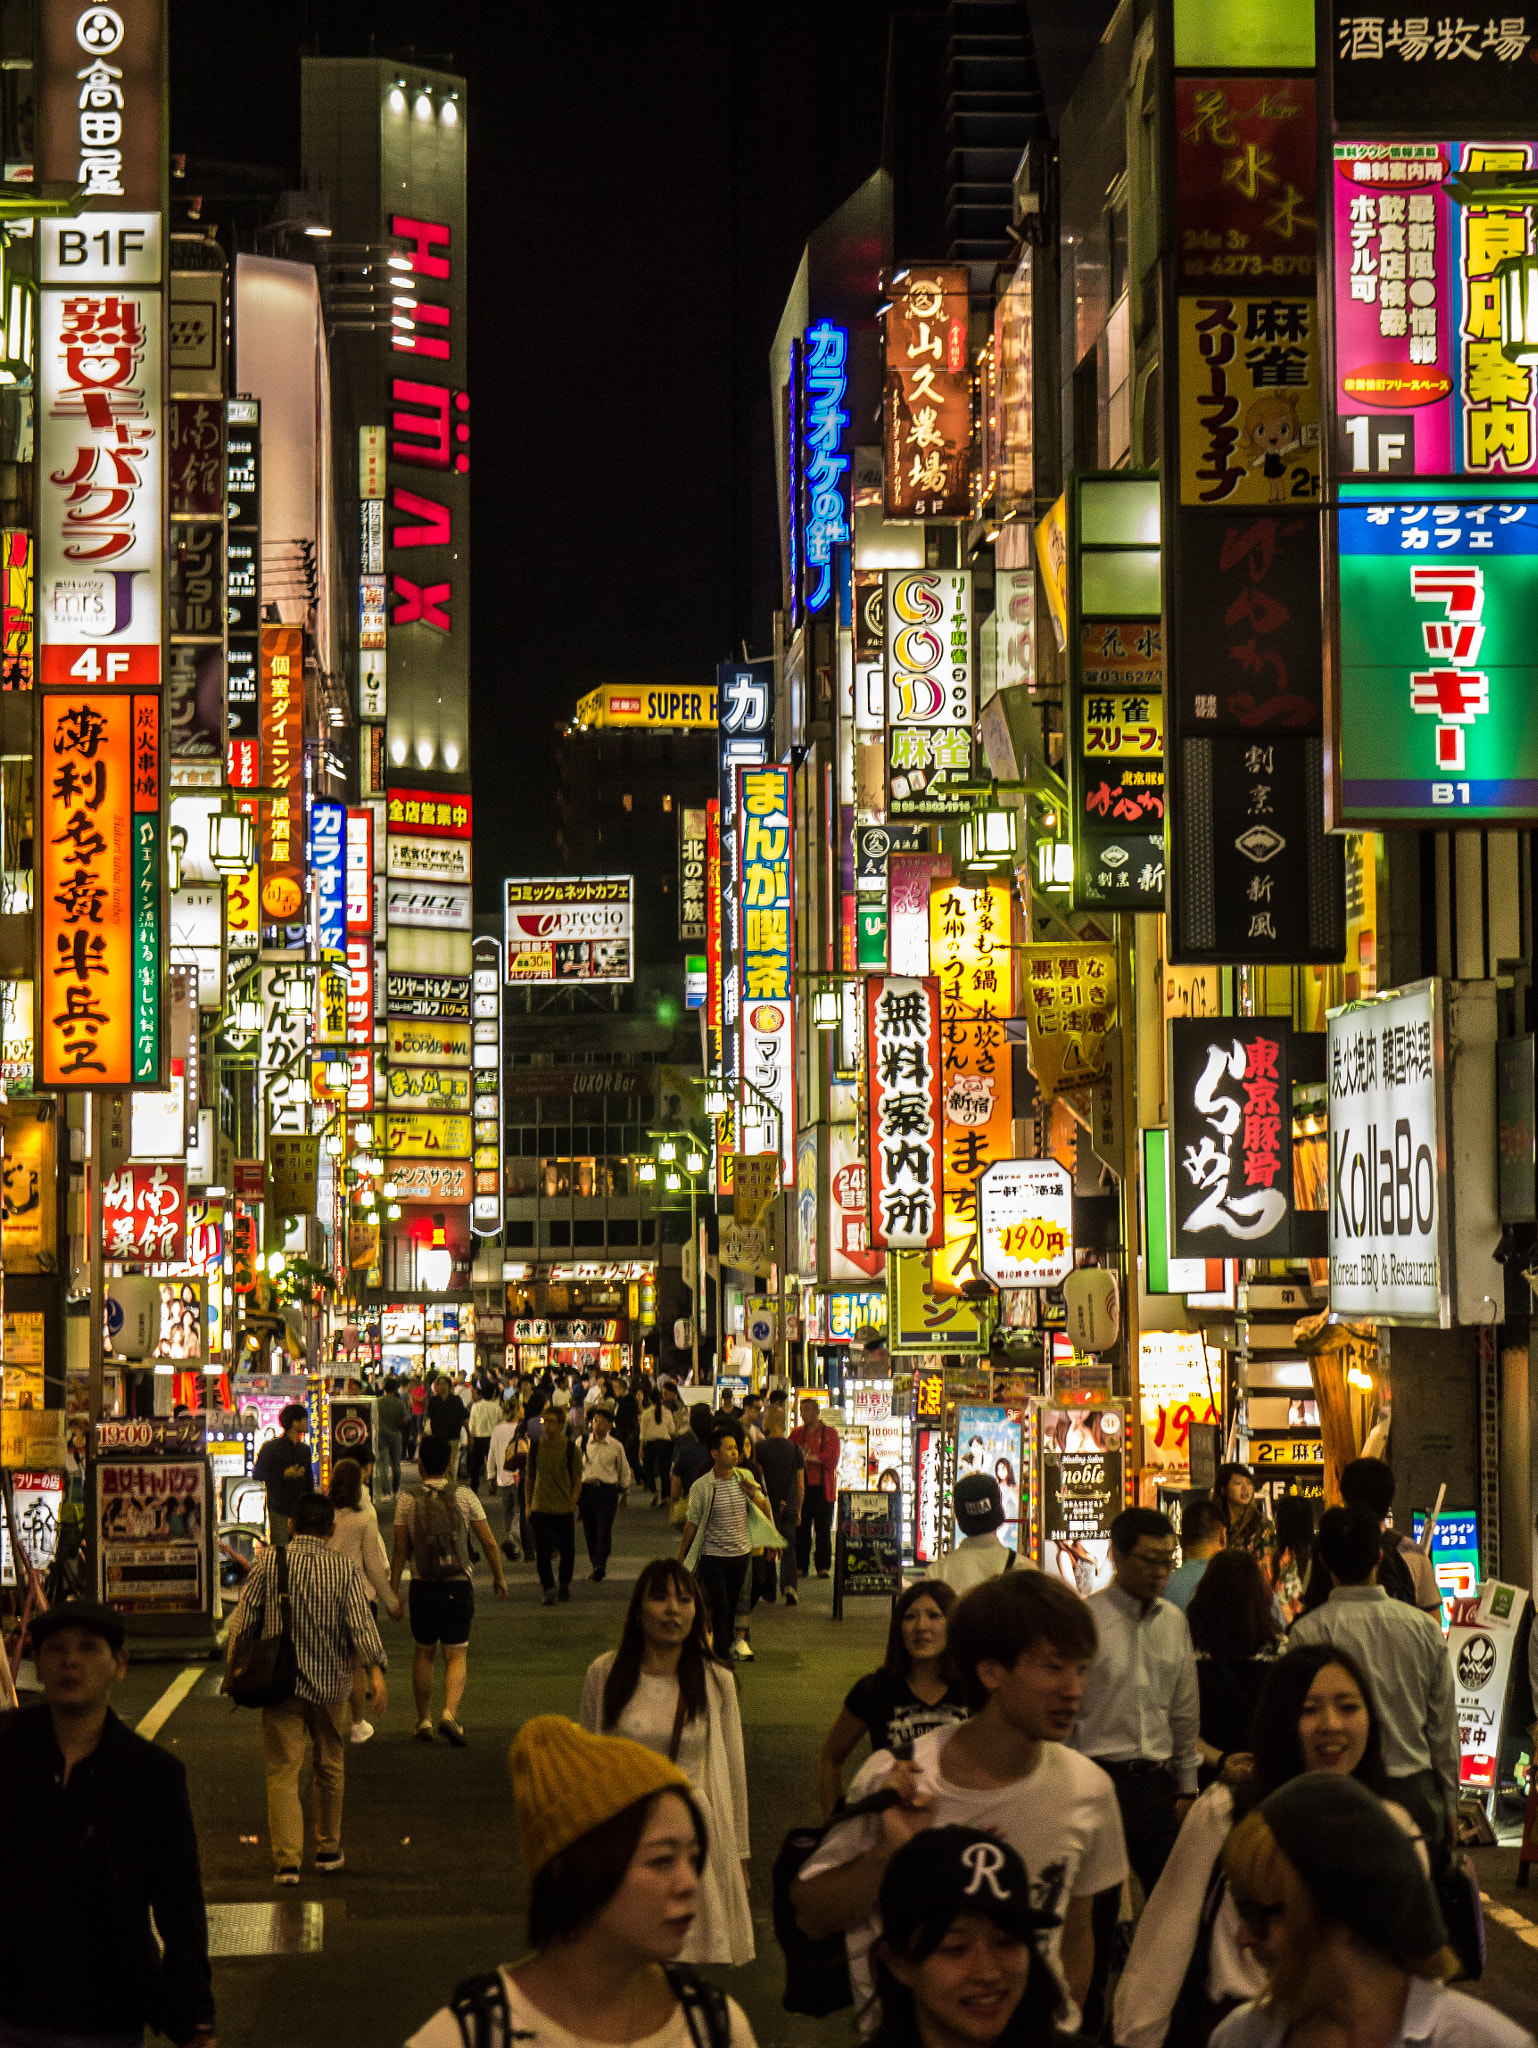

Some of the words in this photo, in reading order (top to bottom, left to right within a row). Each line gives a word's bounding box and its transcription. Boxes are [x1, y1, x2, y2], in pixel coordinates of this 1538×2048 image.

[1340, 17, 1531, 62] 酒場牧場
[1353, 162, 1443, 181] 無料案内所
[58, 230, 146, 267] B1F
[1350, 194, 1378, 304] ホテル可
[1245, 302, 1309, 389] 麻雀
[906, 321, 949, 493] 山久農場
[1194, 301, 1249, 502] スリーファイブ
[1346, 416, 1406, 473] 1F
[1367, 504, 1528, 525] オンライン
[1400, 528, 1495, 549] カフェ
[951, 577, 967, 665] リーチ麻雀
[69, 647, 131, 682] 4F
[892, 572, 947, 723] GOD
[1409, 565, 1490, 771] ラッキー
[648, 691, 702, 721] SUPER
[1087, 697, 1151, 723] 麻雀
[890, 726, 972, 770] 麻雀
[1431, 784, 1471, 805] B1
[388, 798, 469, 829] 全店営業中
[312, 806, 343, 925] カラオケ
[682, 840, 706, 923] 北の家族
[509, 883, 629, 901] コミック&ネットカフェ
[743, 772, 790, 1000] まんが喫茶
[387, 976, 470, 1000] ビリヤード&ダーツ
[412, 1000, 440, 1015] ゴルフ
[1332, 1029, 1378, 1098] 炭火焼肉
[1381, 1020, 1433, 1090] 韓国料理
[389, 1069, 468, 1097] まんが喫茶
[879, 987, 931, 1238] 無料案内所
[948, 1092, 990, 1114] 新宿
[963, 1113, 980, 1127] の
[1242, 1035, 1281, 1188] 東京豚骨
[389, 1126, 441, 1150] ゲーム
[391, 1165, 465, 1189] メンズサウナ
[1333, 1117, 1434, 1239] KollaBo
[1003, 1225, 1065, 1252] 190円
[1331, 1252, 1360, 1287] Korean
[1360, 1254, 1379, 1293] BBQ
[1389, 1253, 1440, 1288] Restaurant
[385, 1323, 422, 1337] ゲーム
[98, 1424, 152, 1446] 19:00
[1257, 1443, 1286, 1464] 2F
[1061, 1464, 1105, 1485] noble
[961, 1841, 1011, 1900] R
